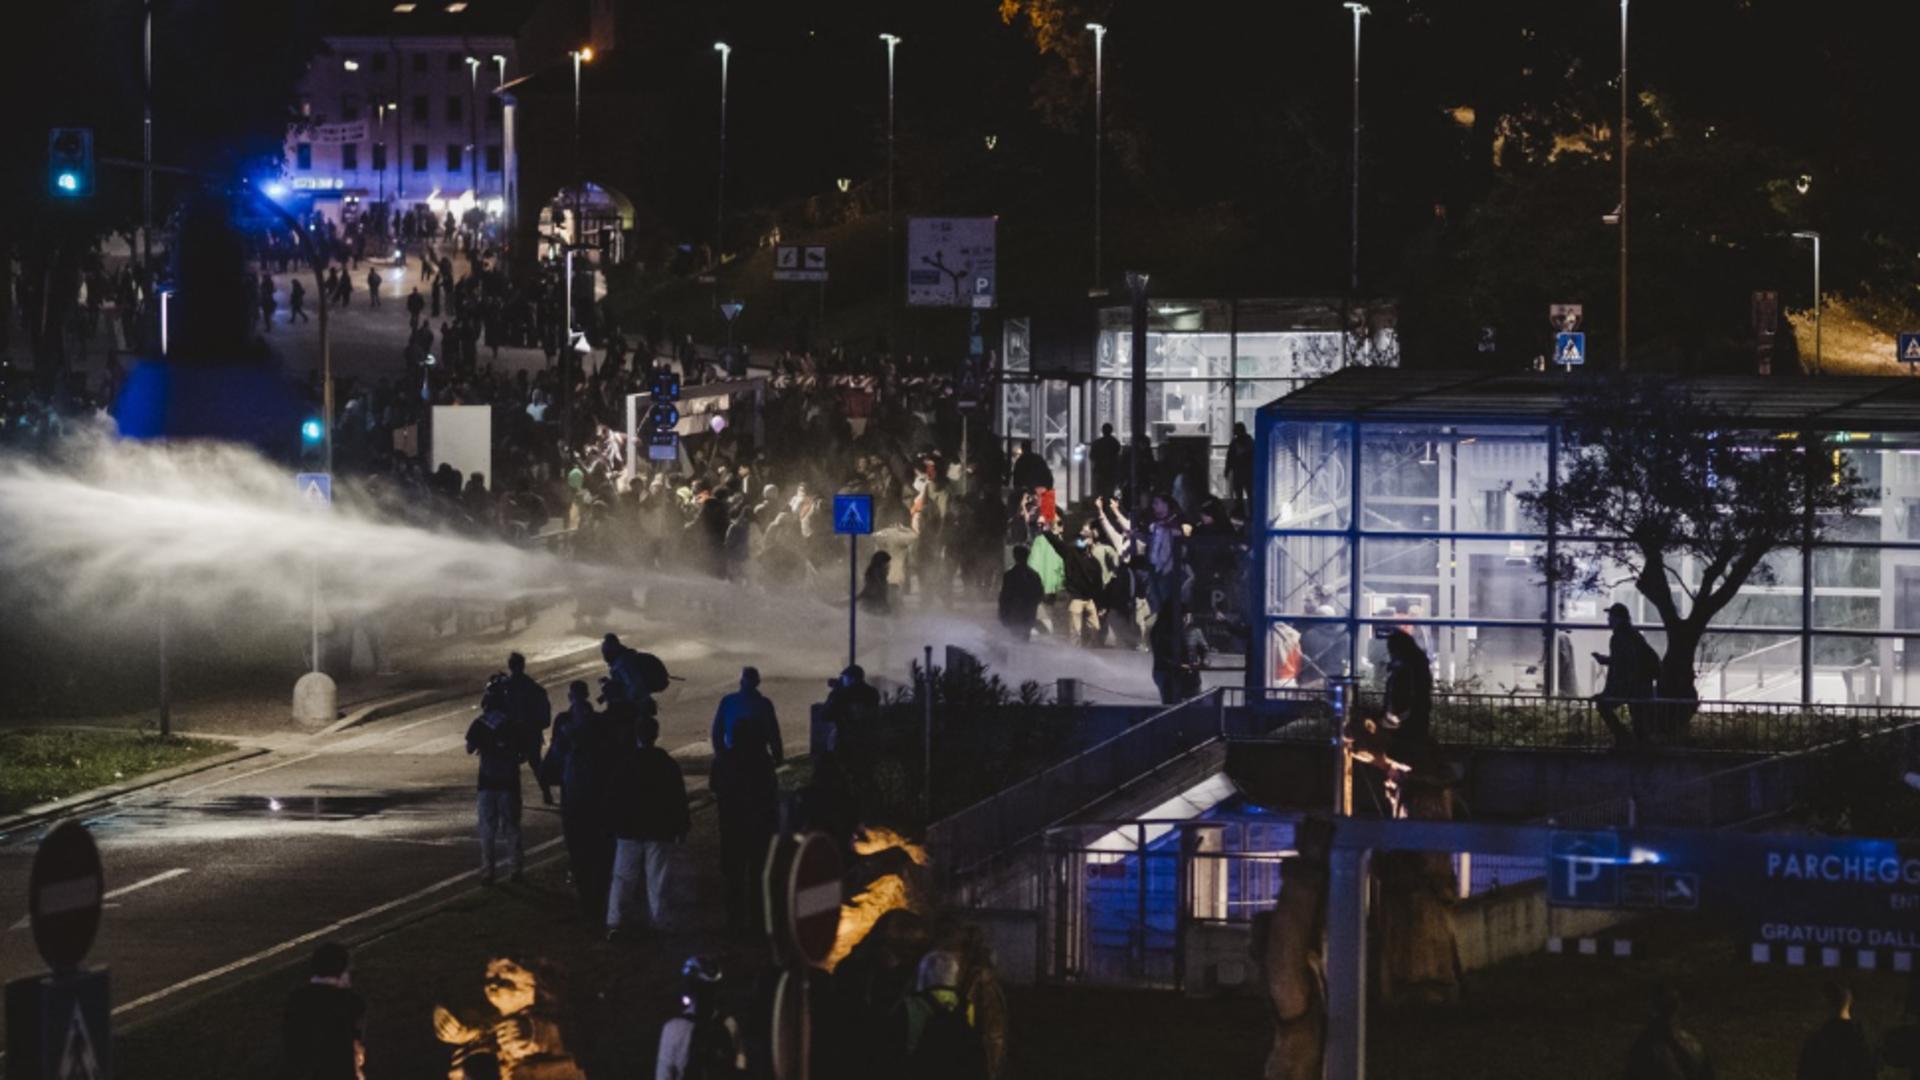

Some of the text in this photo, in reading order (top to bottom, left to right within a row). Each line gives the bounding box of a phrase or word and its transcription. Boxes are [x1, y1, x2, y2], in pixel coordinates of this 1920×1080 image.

[976, 278, 989, 293] P
[1568, 855, 1601, 897] P
[1766, 853, 1920, 883] PARCHEGG
[1761, 923, 1920, 949] GRATUITO DALL
